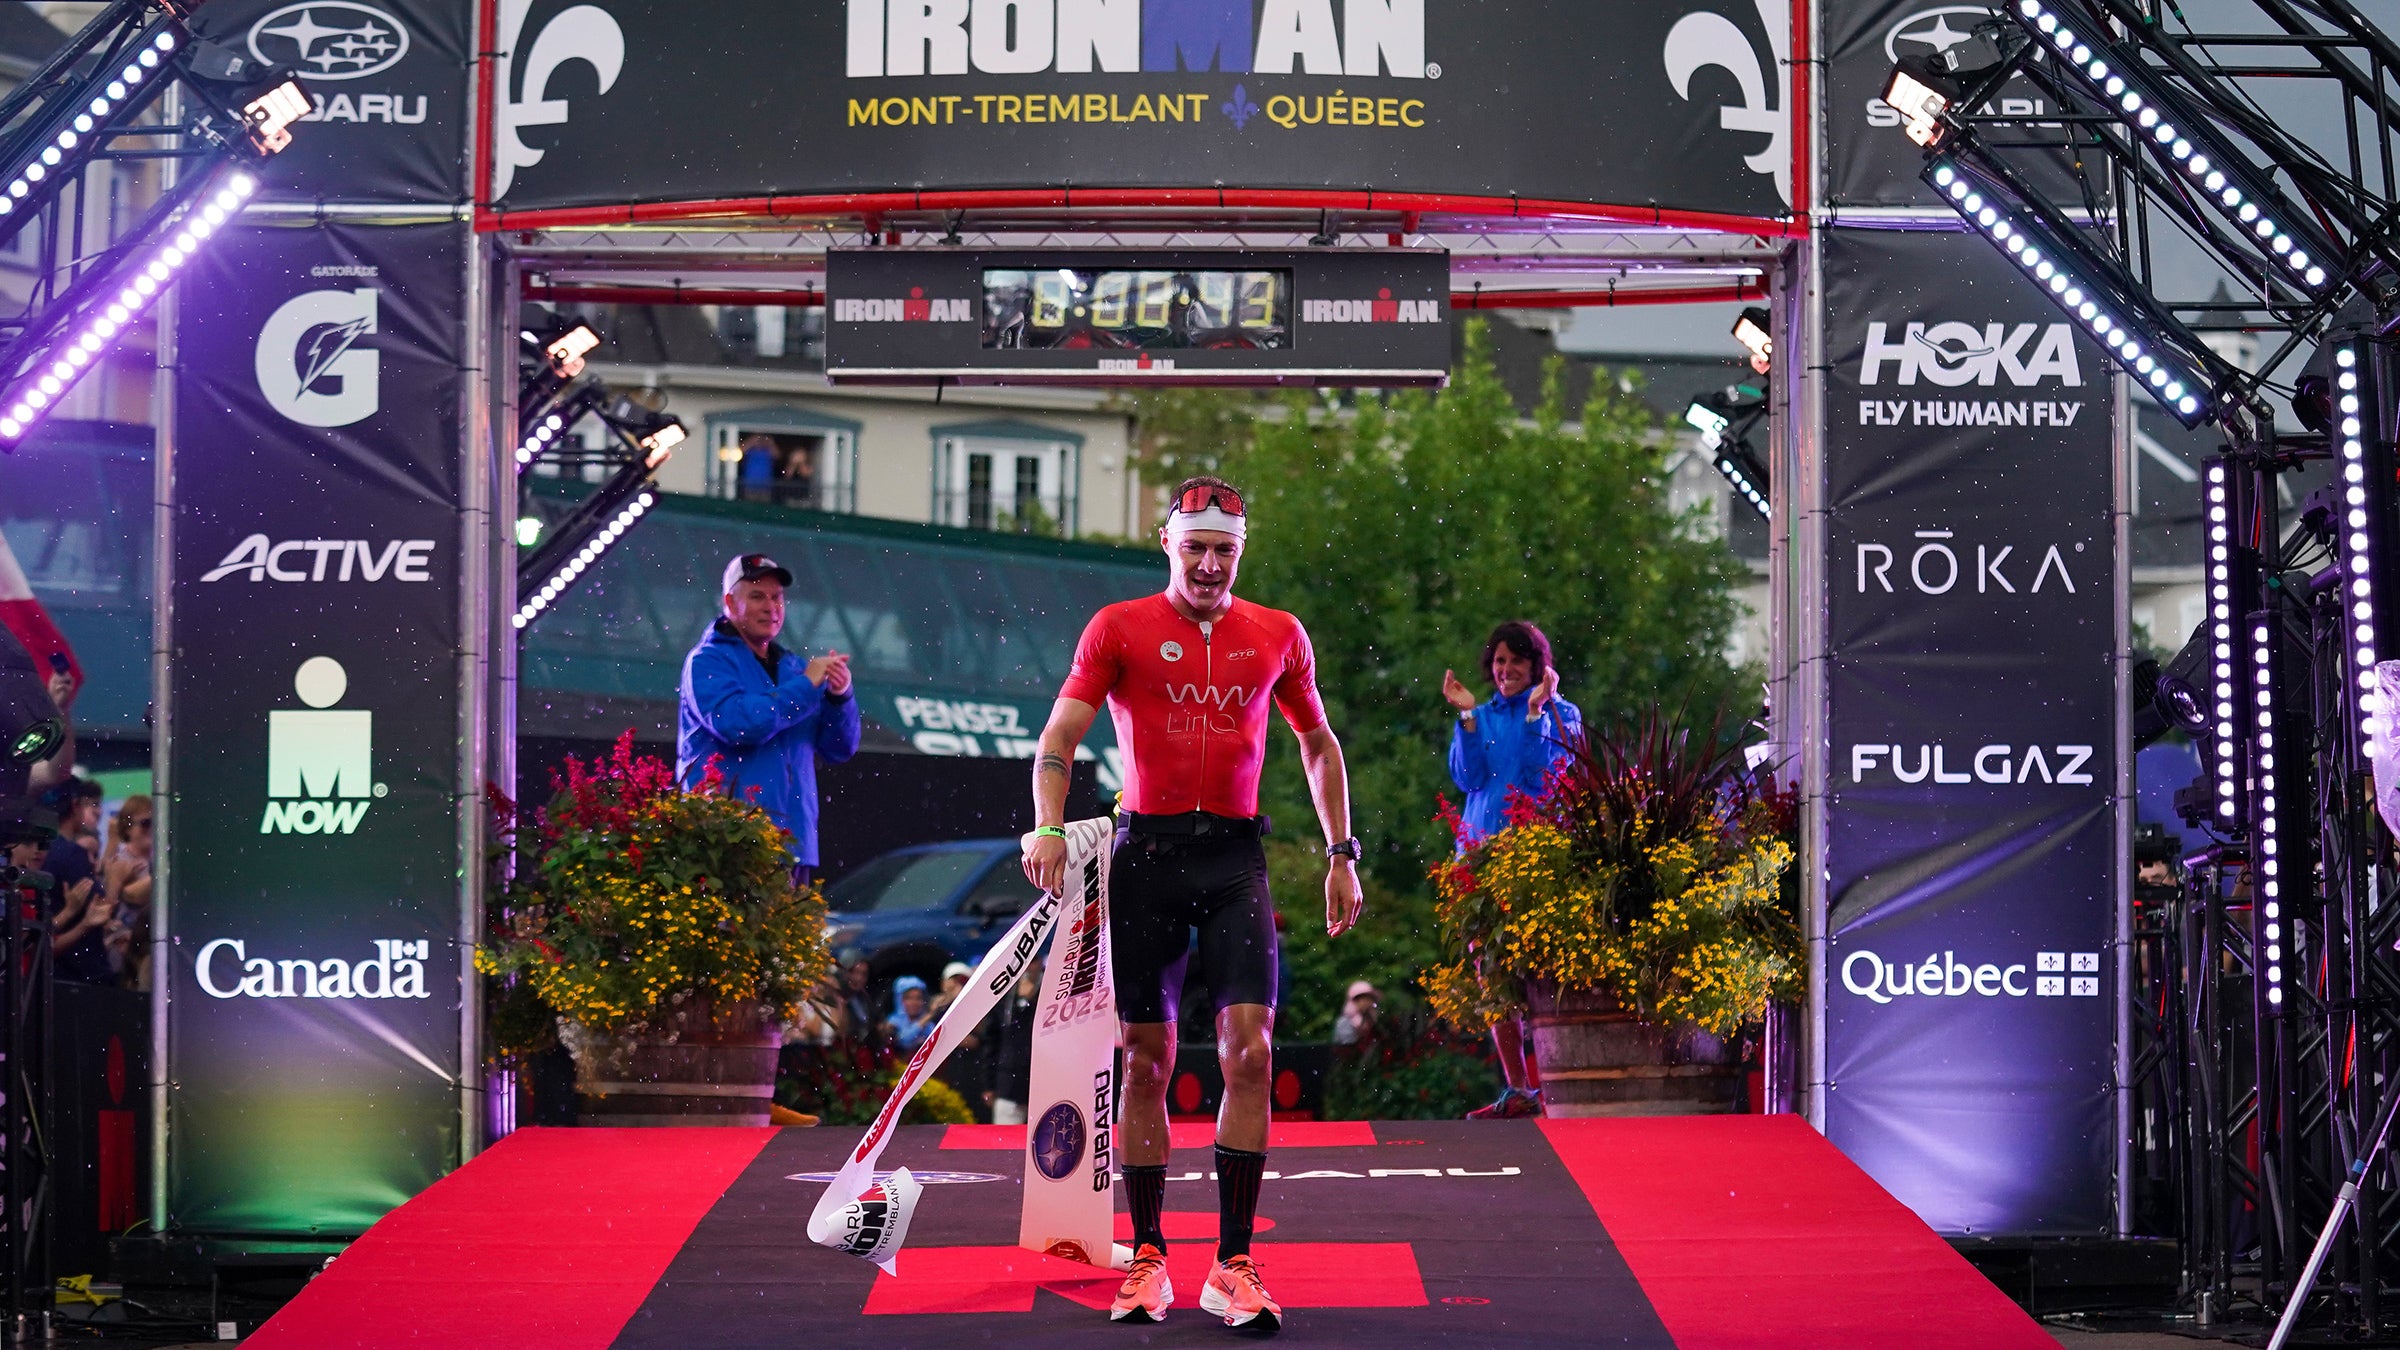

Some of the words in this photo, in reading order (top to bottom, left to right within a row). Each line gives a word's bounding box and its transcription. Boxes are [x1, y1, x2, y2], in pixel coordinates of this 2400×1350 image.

[846, 0, 1425, 78] IRONMAN
[848, 94, 1209, 127] MONT-TREMBLANT
[1266, 90, 1425, 129] QUÉBEC
[311, 266, 379, 278] GATORADE
[834, 293, 971, 323] IRONMAN
[1303, 294, 1438, 323] IRONMAN
[1860, 322, 2082, 387] HOKA
[1860, 401, 1908, 426] FLY
[1913, 401, 2028, 426] HUMAN
[2033, 401, 2082, 427] FLY
[200, 533, 436, 582] ACTIVE
[894, 695, 1030, 737] PENSEZ
[1852, 744, 2093, 784] FULGAZ
[260, 801, 371, 835] NOW
[195, 938, 431, 999] Canada
[1055, 938, 1082, 1001] SUBARU
[1841, 950, 2029, 1004] Québec
[1042, 986, 1111, 1030] 2022
[1092, 1069, 1111, 1193] SUBARU
